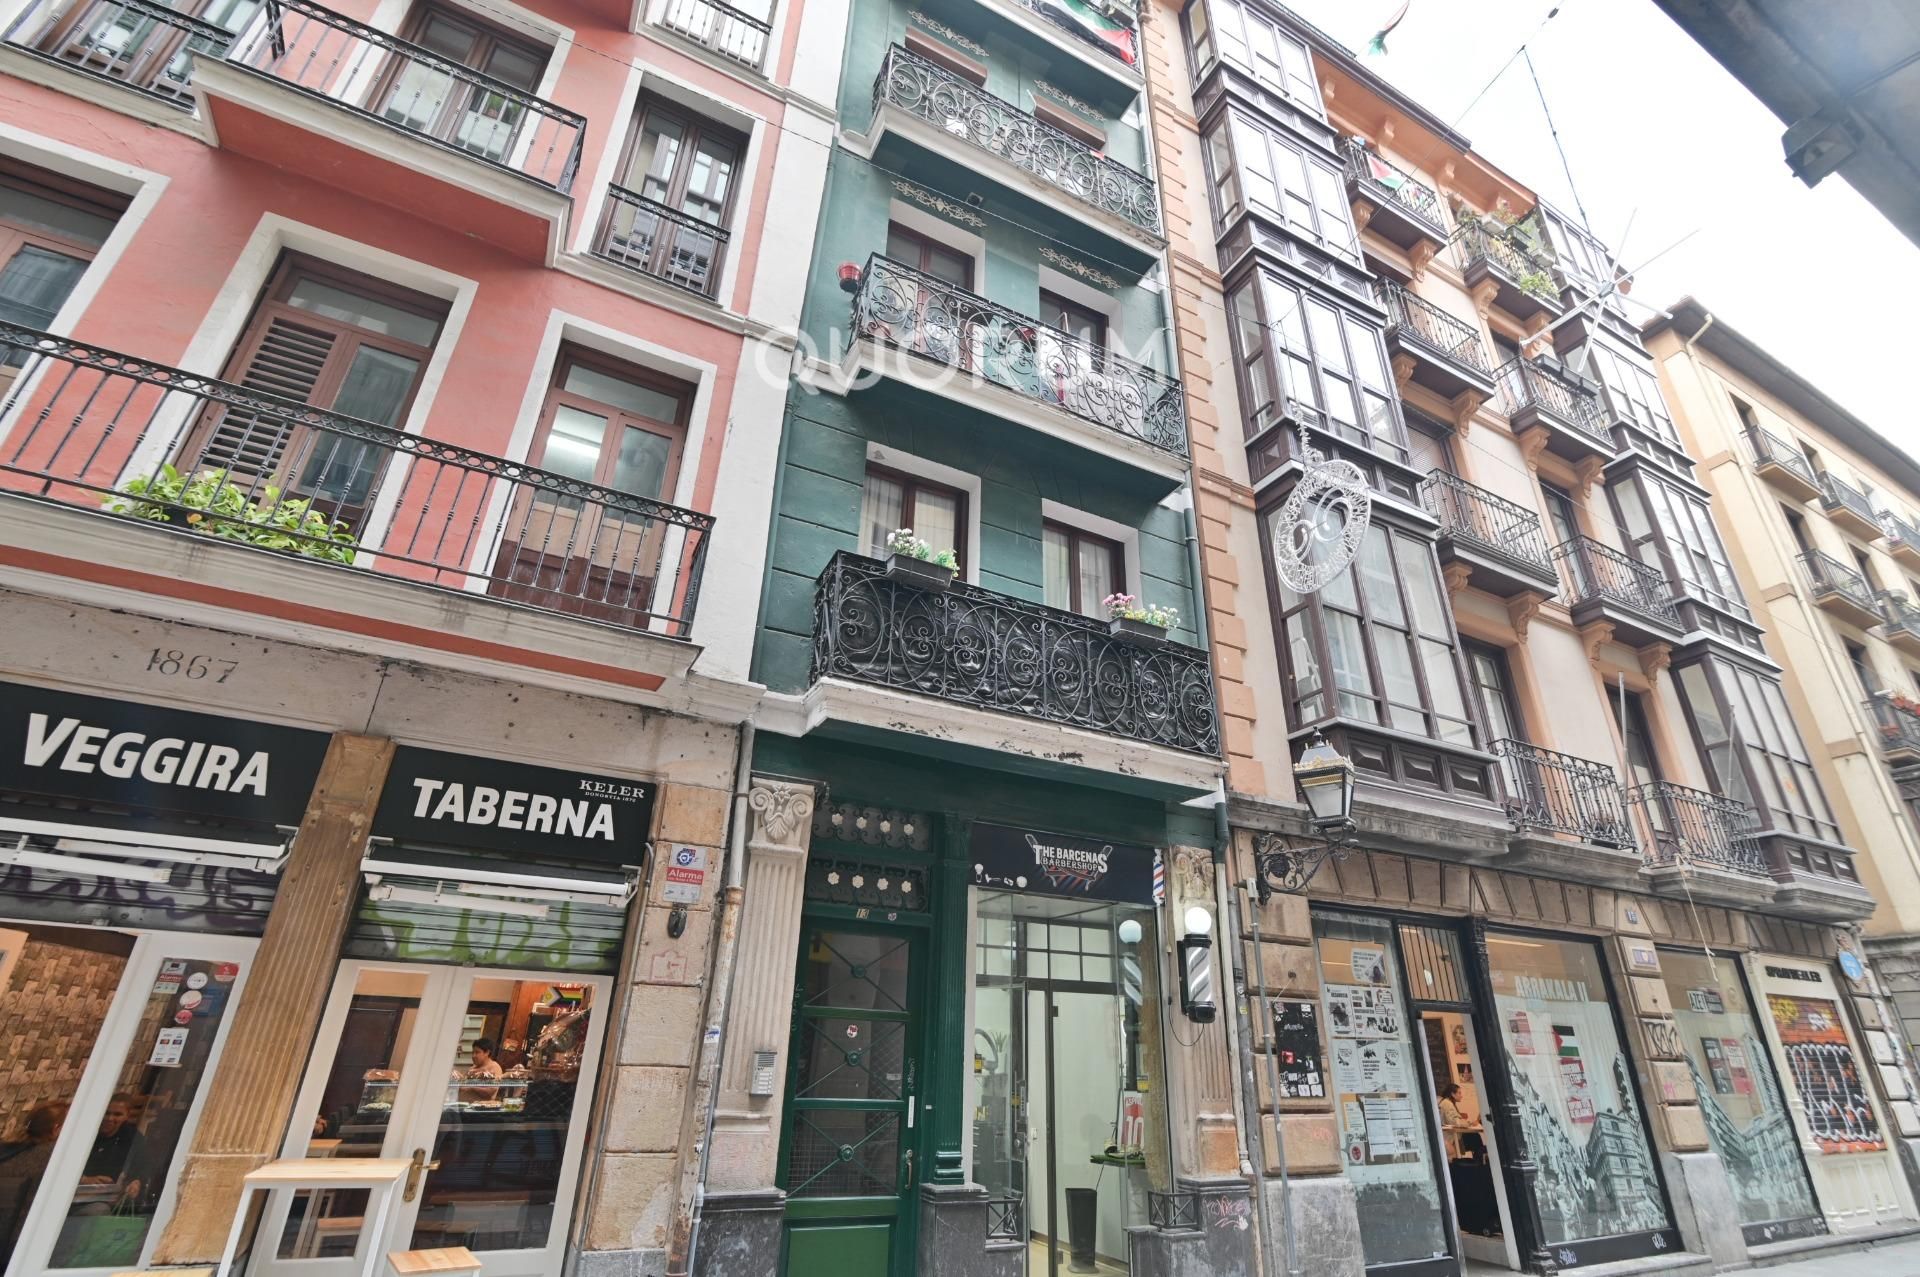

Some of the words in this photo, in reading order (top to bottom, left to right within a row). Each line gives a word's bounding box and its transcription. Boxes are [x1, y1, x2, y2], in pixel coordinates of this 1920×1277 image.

[146, 647, 240, 684] 1867
[23, 712, 270, 796] VEGGIRA
[579, 779, 645, 799] KELER
[412, 777, 615, 841] TABERNA
[1032, 844, 1055, 865] THE
[1057, 847, 1108, 874] BARCENAS
[1042, 858, 1098, 872] BARBERSHOP
[668, 868, 703, 881] Alarma
